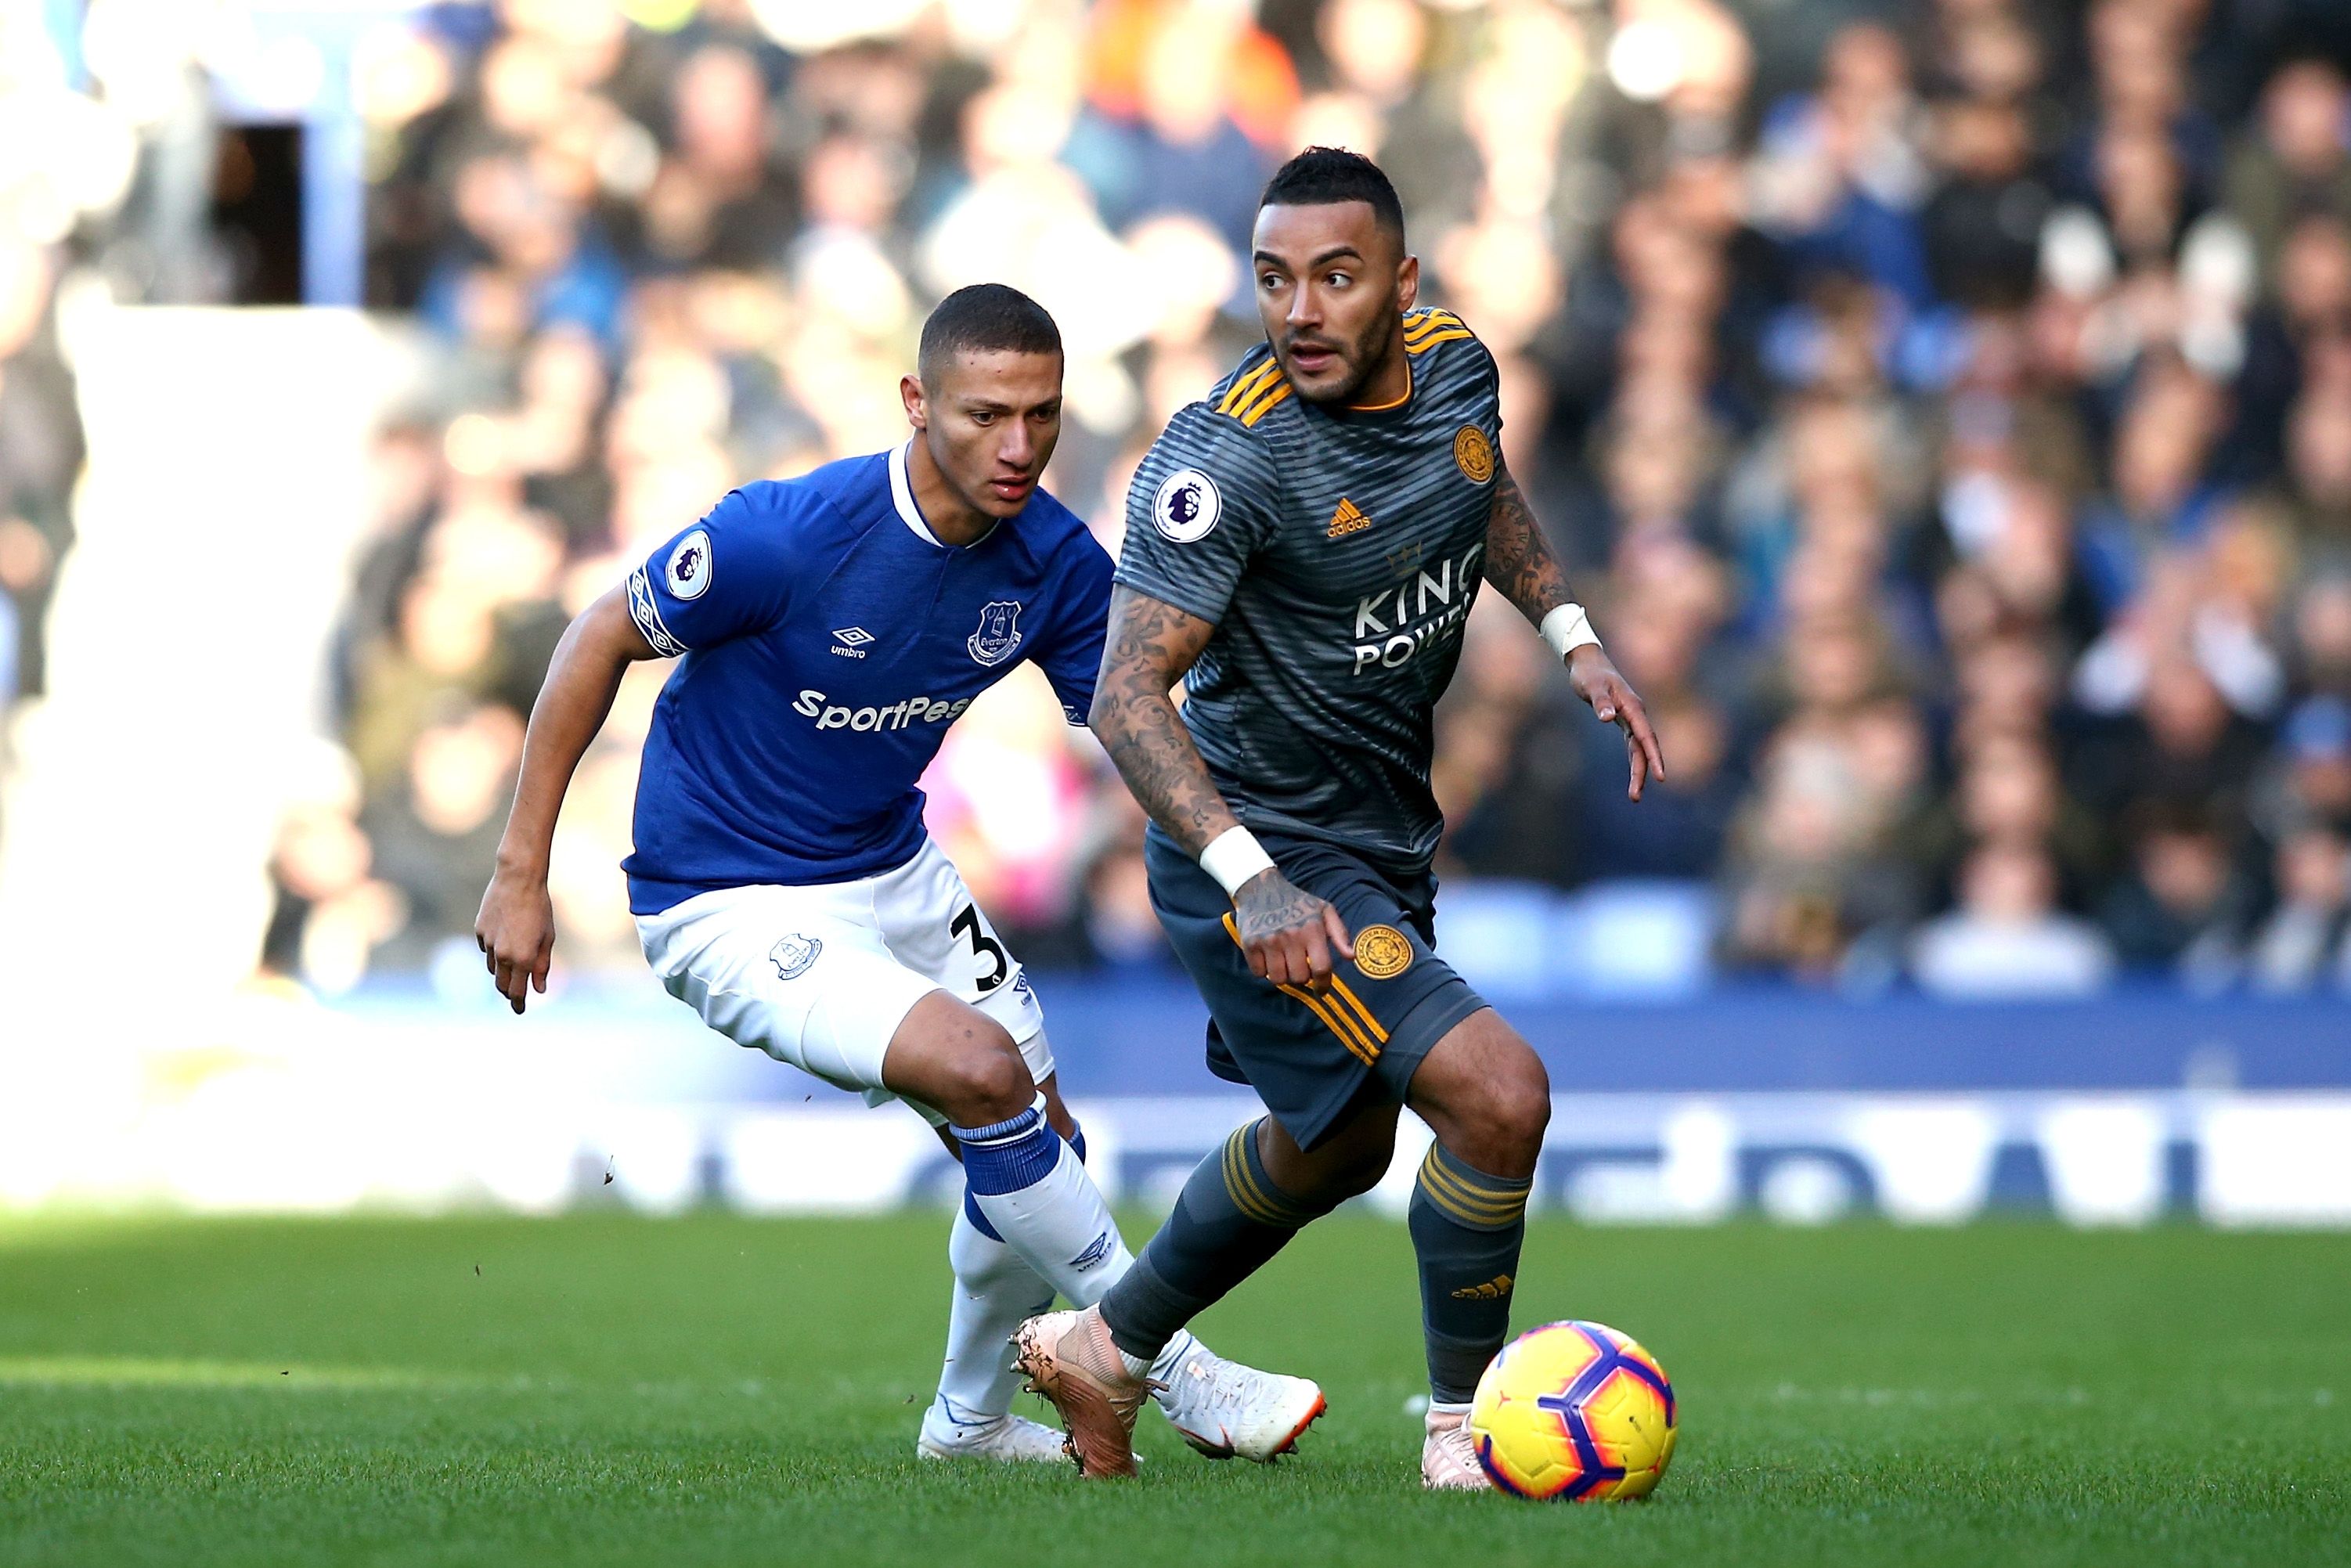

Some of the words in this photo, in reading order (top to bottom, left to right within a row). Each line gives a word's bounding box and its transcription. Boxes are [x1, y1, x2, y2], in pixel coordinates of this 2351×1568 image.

[1327, 515, 1372, 538] adidas
[831, 645, 866, 659] umbro
[950, 903, 1007, 992] 3
[1358, 930, 1379, 964] LEICESTER
[1078, 1242, 1111, 1272] umbro
